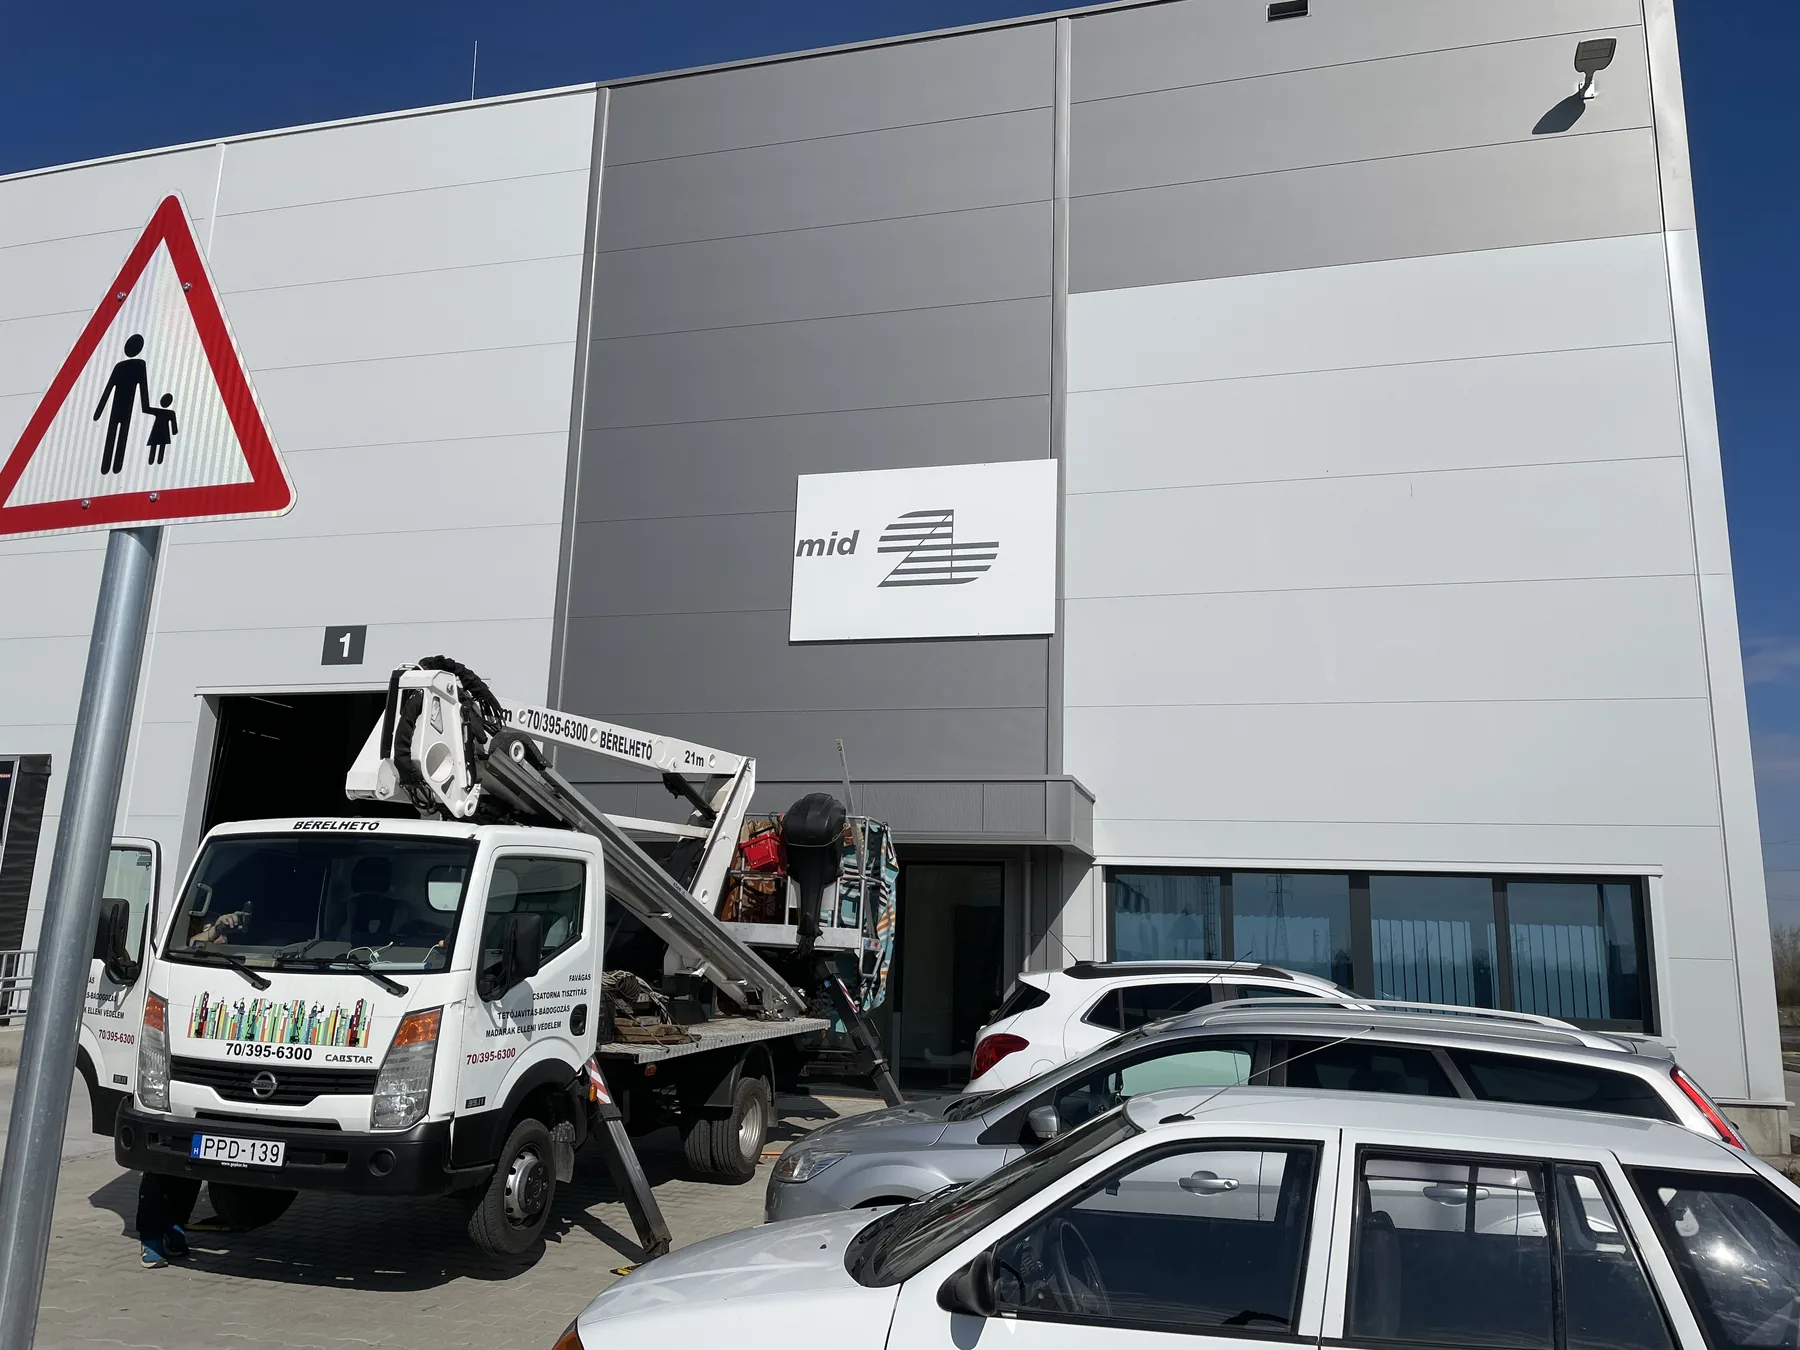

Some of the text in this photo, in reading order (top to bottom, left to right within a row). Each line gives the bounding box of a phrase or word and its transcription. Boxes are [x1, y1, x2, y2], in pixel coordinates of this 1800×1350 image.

[796, 529, 860, 557] mid
[339, 632, 351, 658] 1
[526, 709, 589, 742] 70/395-6300
[599, 729, 653, 761] BÉRELHETŐ
[684, 750, 705, 767] 21m
[292, 820, 380, 831] BÉRELHETŐ
[532, 988, 587, 1001] CSATORNA TISZTÍTÁS
[98, 1029, 135, 1045] 70/395-6300
[485, 1026, 516, 1038] MADARAK
[516, 1023, 537, 1034] ELLENI
[225, 1042, 313, 1061] 70/395-6300
[325, 1054, 373, 1064] CABSTAR
[466, 1047, 516, 1066] 70/395-6300
[203, 1138, 280, 1163] PPD-139
